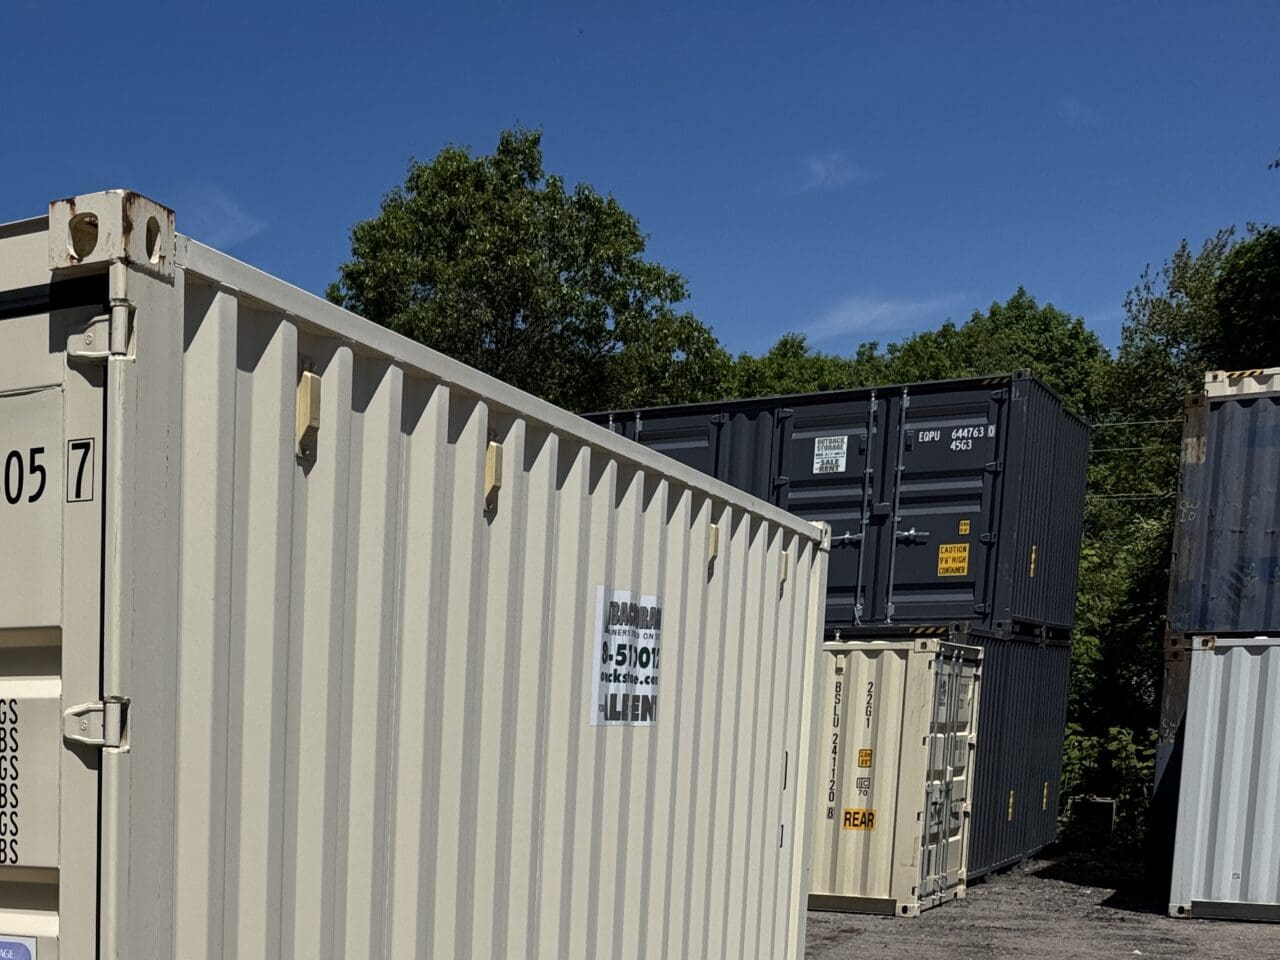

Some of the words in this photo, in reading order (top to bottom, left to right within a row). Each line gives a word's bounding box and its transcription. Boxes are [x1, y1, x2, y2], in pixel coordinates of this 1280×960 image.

[950, 439, 973, 451] 45G3
[951, 426, 985, 439] 644763
[71, 441, 91, 499] 7
[940, 545, 967, 553] CAUTION
[832, 681, 842, 728] BSLU
[865, 681, 874, 729] 22G1
[828, 732, 839, 802] 241120
[843, 811, 875, 828] REAR
